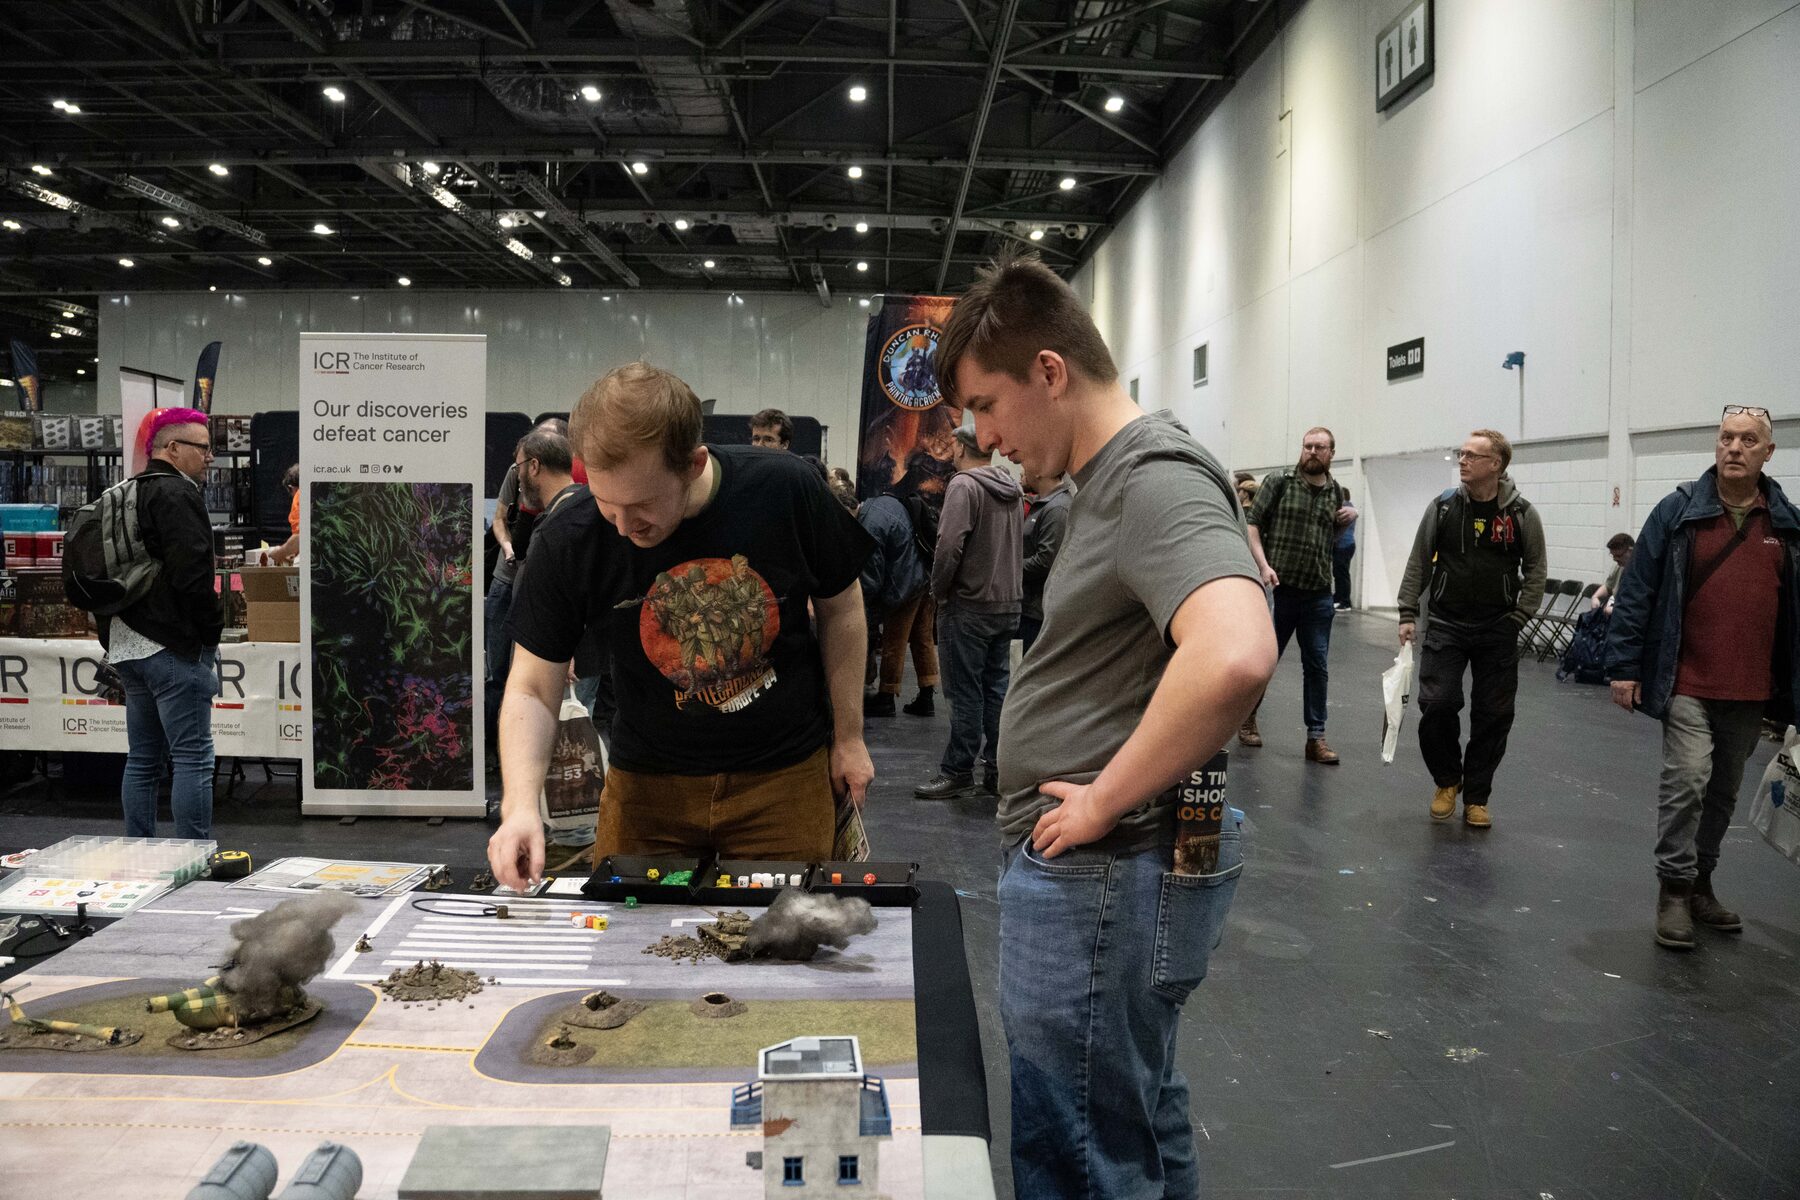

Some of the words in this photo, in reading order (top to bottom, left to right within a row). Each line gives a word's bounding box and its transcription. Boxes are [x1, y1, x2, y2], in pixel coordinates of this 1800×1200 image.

[883, 328, 920, 363] DUNCAN
[923, 328, 941, 342] RH
[314, 352, 350, 370] ICR
[353, 352, 370, 361] The
[371, 352, 408, 361] Institute
[409, 353, 419, 361] of
[353, 362, 383, 371] Cancer
[385, 362, 425, 371] Research
[886, 381, 913, 407] PAINTING
[913, 390, 942, 407] ACADEM
[313, 399, 350, 418] Our
[356, 400, 468, 419] discoveries
[313, 424, 376, 442] defeat
[383, 429, 451, 443] cancer
[313, 464, 351, 473] icr.ac.uk
[720, 684, 761, 714] EUROPE
[19, 716, 26, 724] of
[63, 718, 87, 732] ICR
[4, 723, 31, 731] Research
[218, 729, 246, 737] Research
[564, 768, 582, 781] 53
